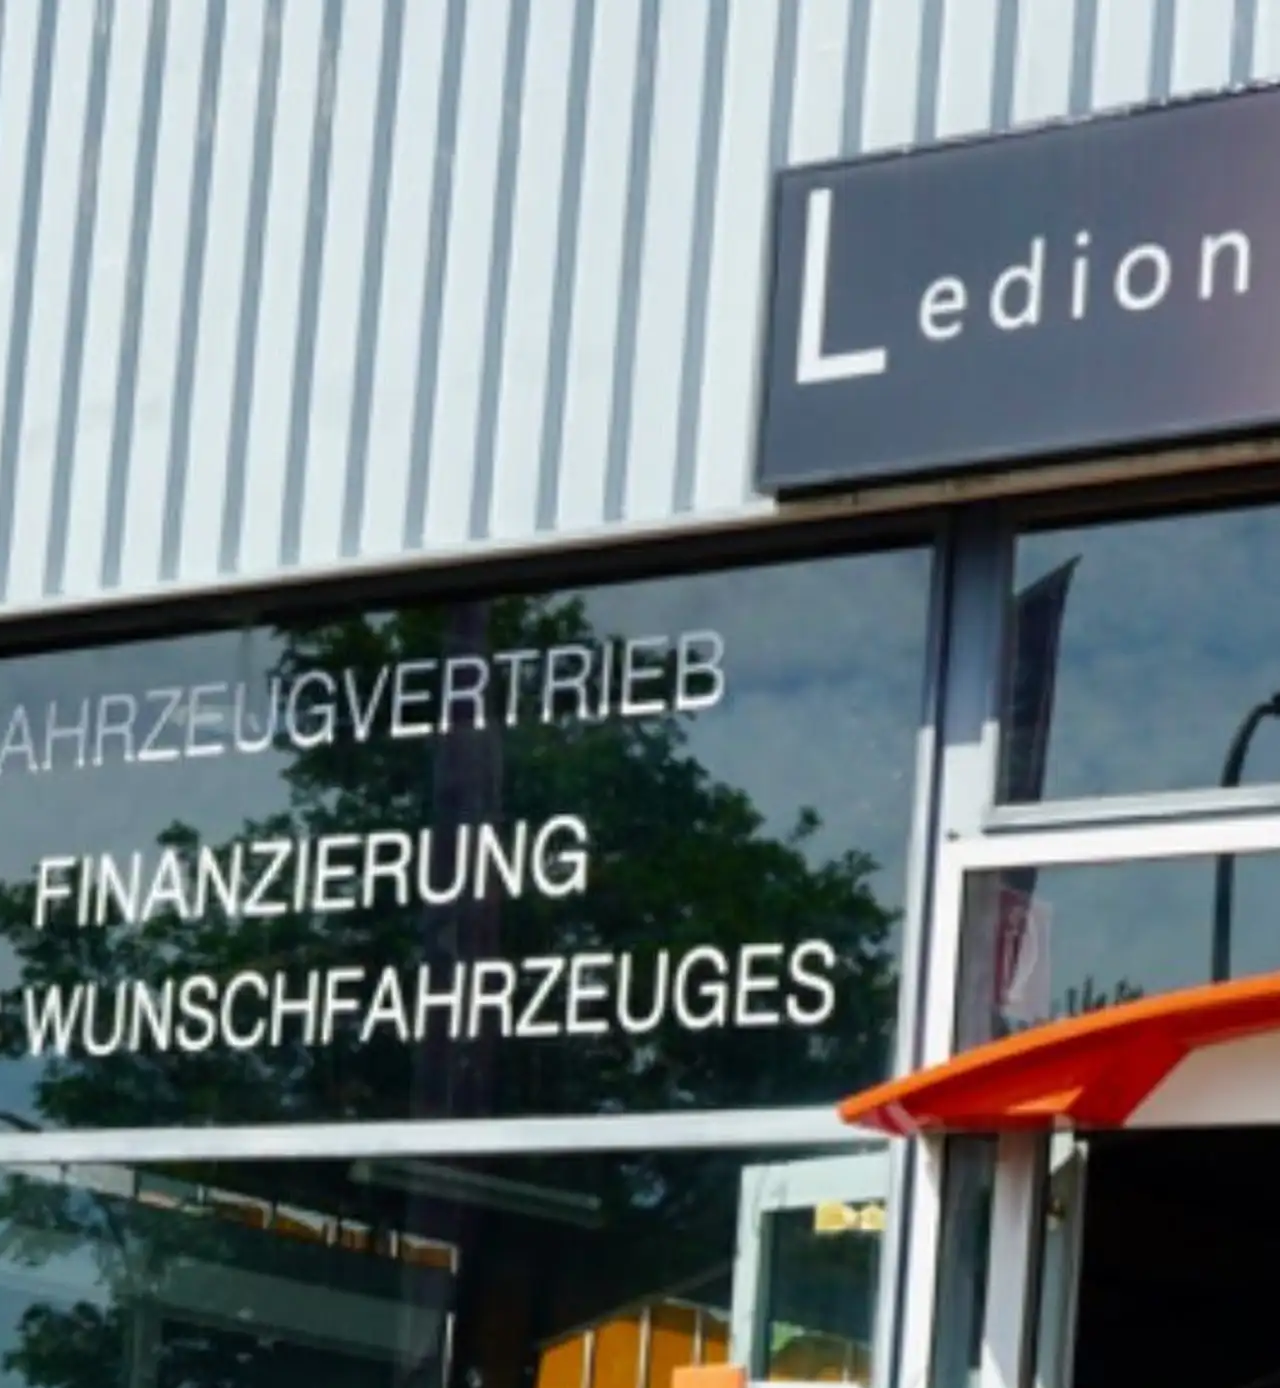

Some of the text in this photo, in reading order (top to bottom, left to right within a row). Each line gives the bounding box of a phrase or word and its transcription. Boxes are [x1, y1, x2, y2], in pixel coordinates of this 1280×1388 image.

[793, 188, 1253, 386] Ledion
[34, 815, 589, 929] FINANZIERUNG
[25, 941, 836, 1060] WUNSCHFAHRZEUGES
